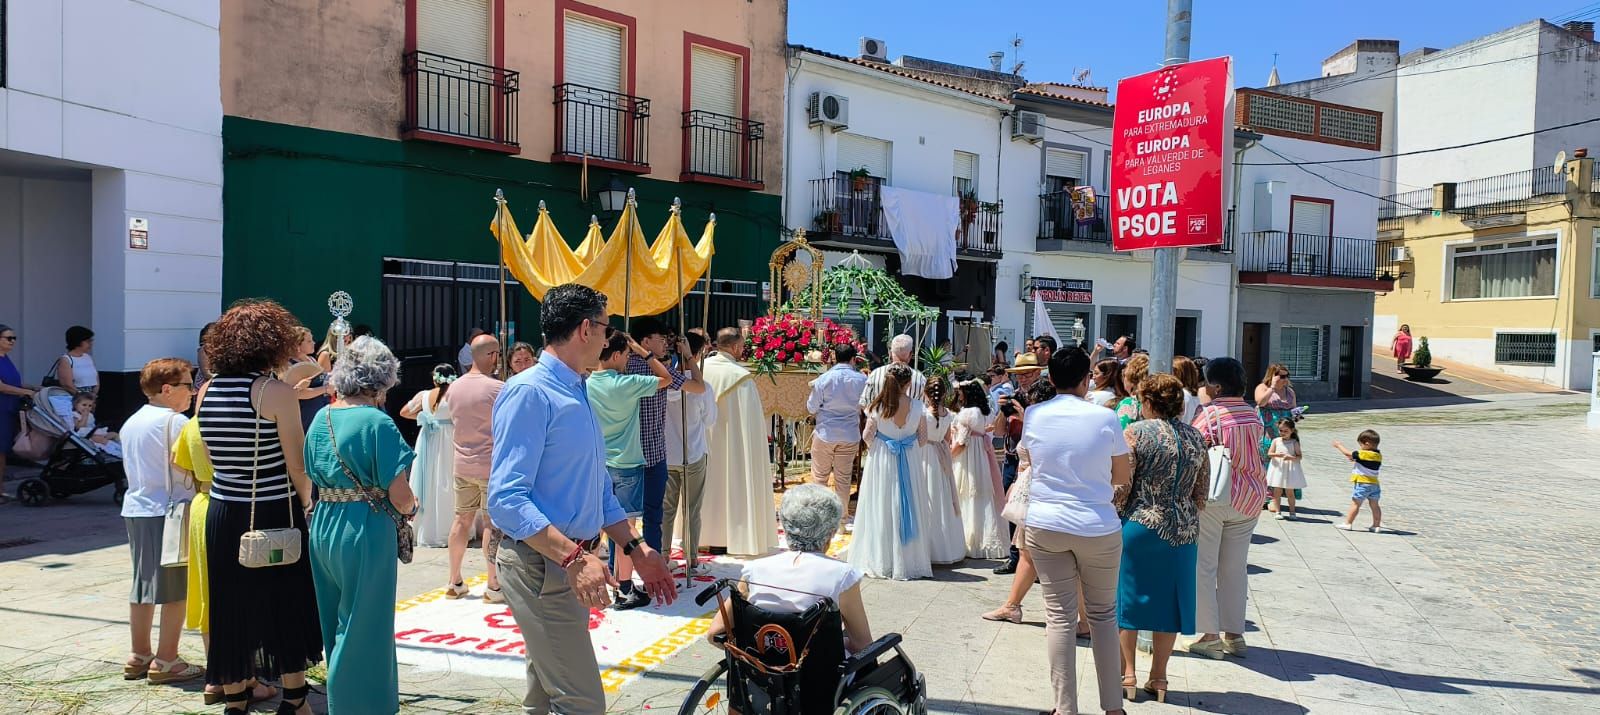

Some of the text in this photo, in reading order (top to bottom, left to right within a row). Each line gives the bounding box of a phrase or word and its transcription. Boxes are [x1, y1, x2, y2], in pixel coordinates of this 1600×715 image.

[1138, 101, 1191, 124] EUROPA
[1123, 115, 1208, 138] PARA EXTREMADURA
[1136, 135, 1190, 155] EUROPA
[1125, 148, 1205, 169] PARA VALVERDE DE
[1118, 181, 1178, 210] VOTA
[1118, 210, 1177, 239] PSOE
[1190, 219, 1205, 227] PSOE
